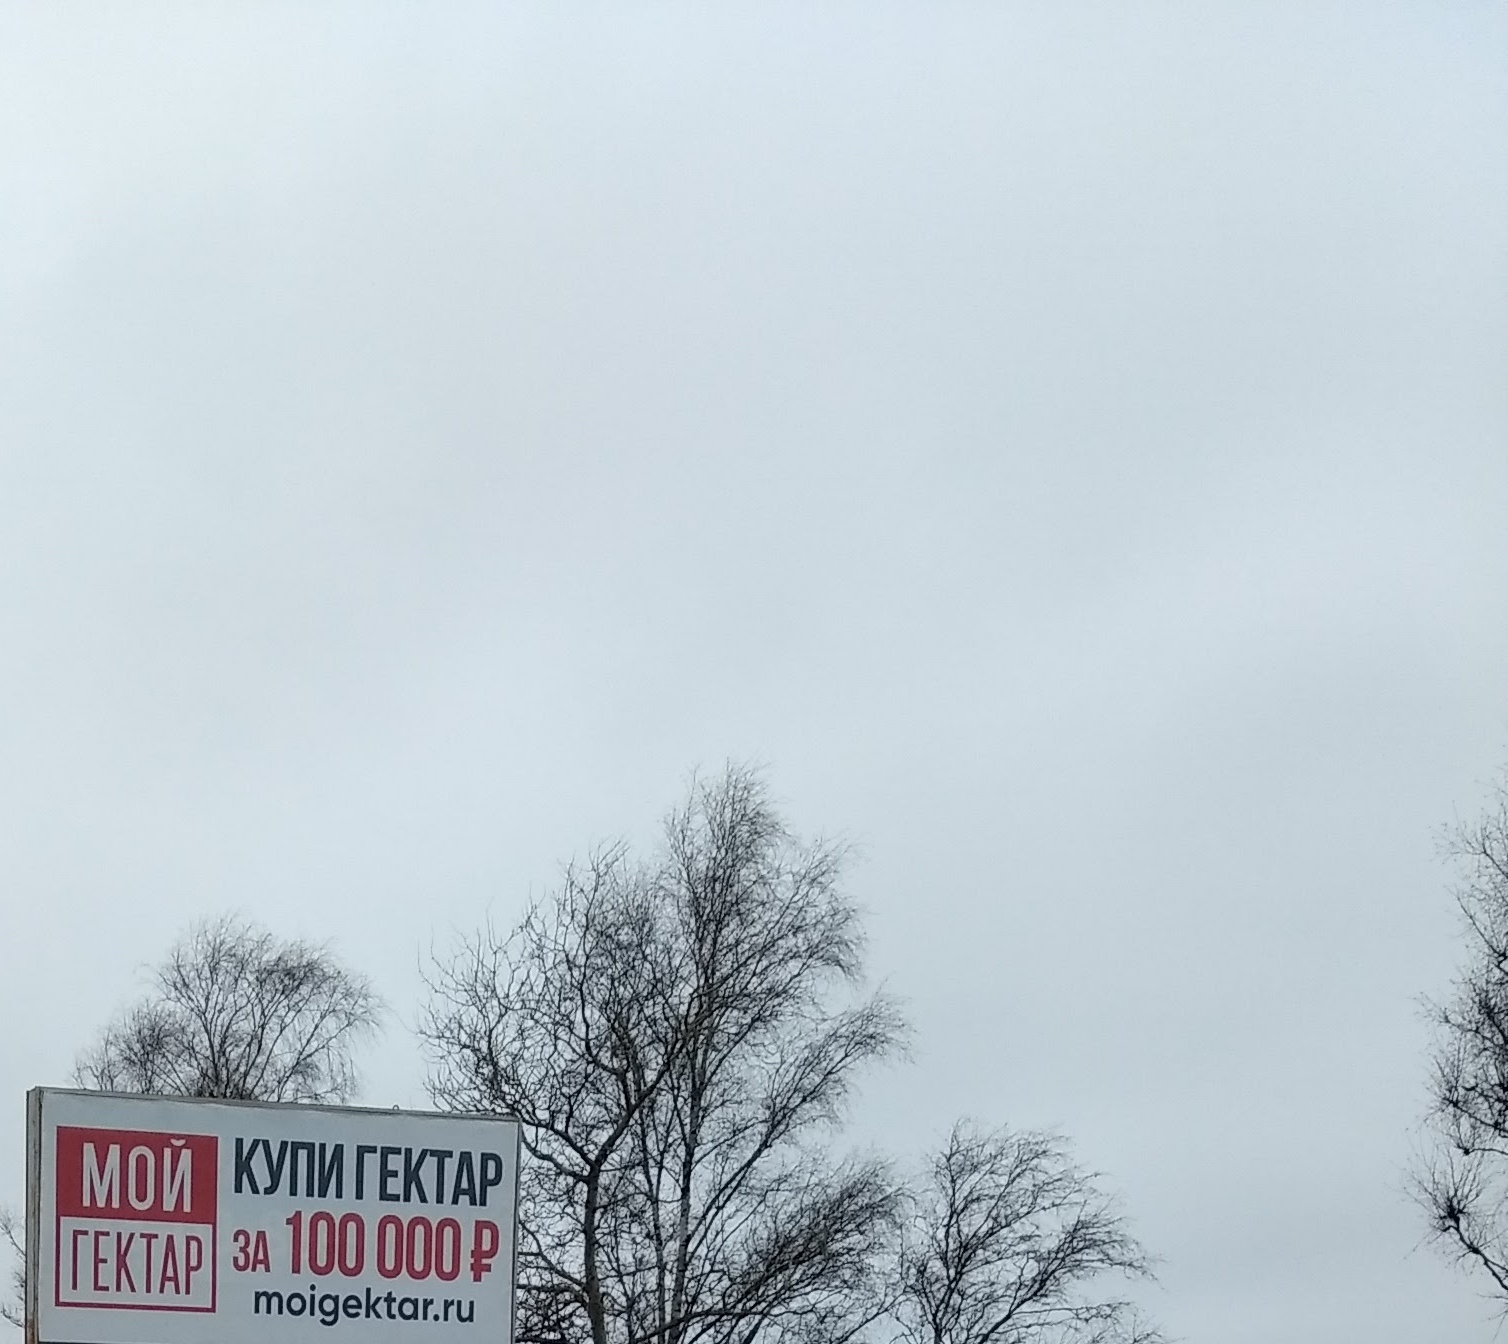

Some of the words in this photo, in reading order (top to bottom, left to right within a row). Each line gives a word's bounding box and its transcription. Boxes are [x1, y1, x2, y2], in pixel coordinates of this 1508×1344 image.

[82, 1138, 192, 1214] МОЙ
[233, 1137, 345, 1200] КУПИ
[355, 1145, 503, 1207] ГЕКТАР
[70, 1229, 203, 1296] ГЕКТАР
[232, 1229, 271, 1274] ЗА
[285, 1210, 366, 1278] 100
[376, 1214, 462, 1282] 000
[253, 1284, 476, 1327] moigektar.ru
